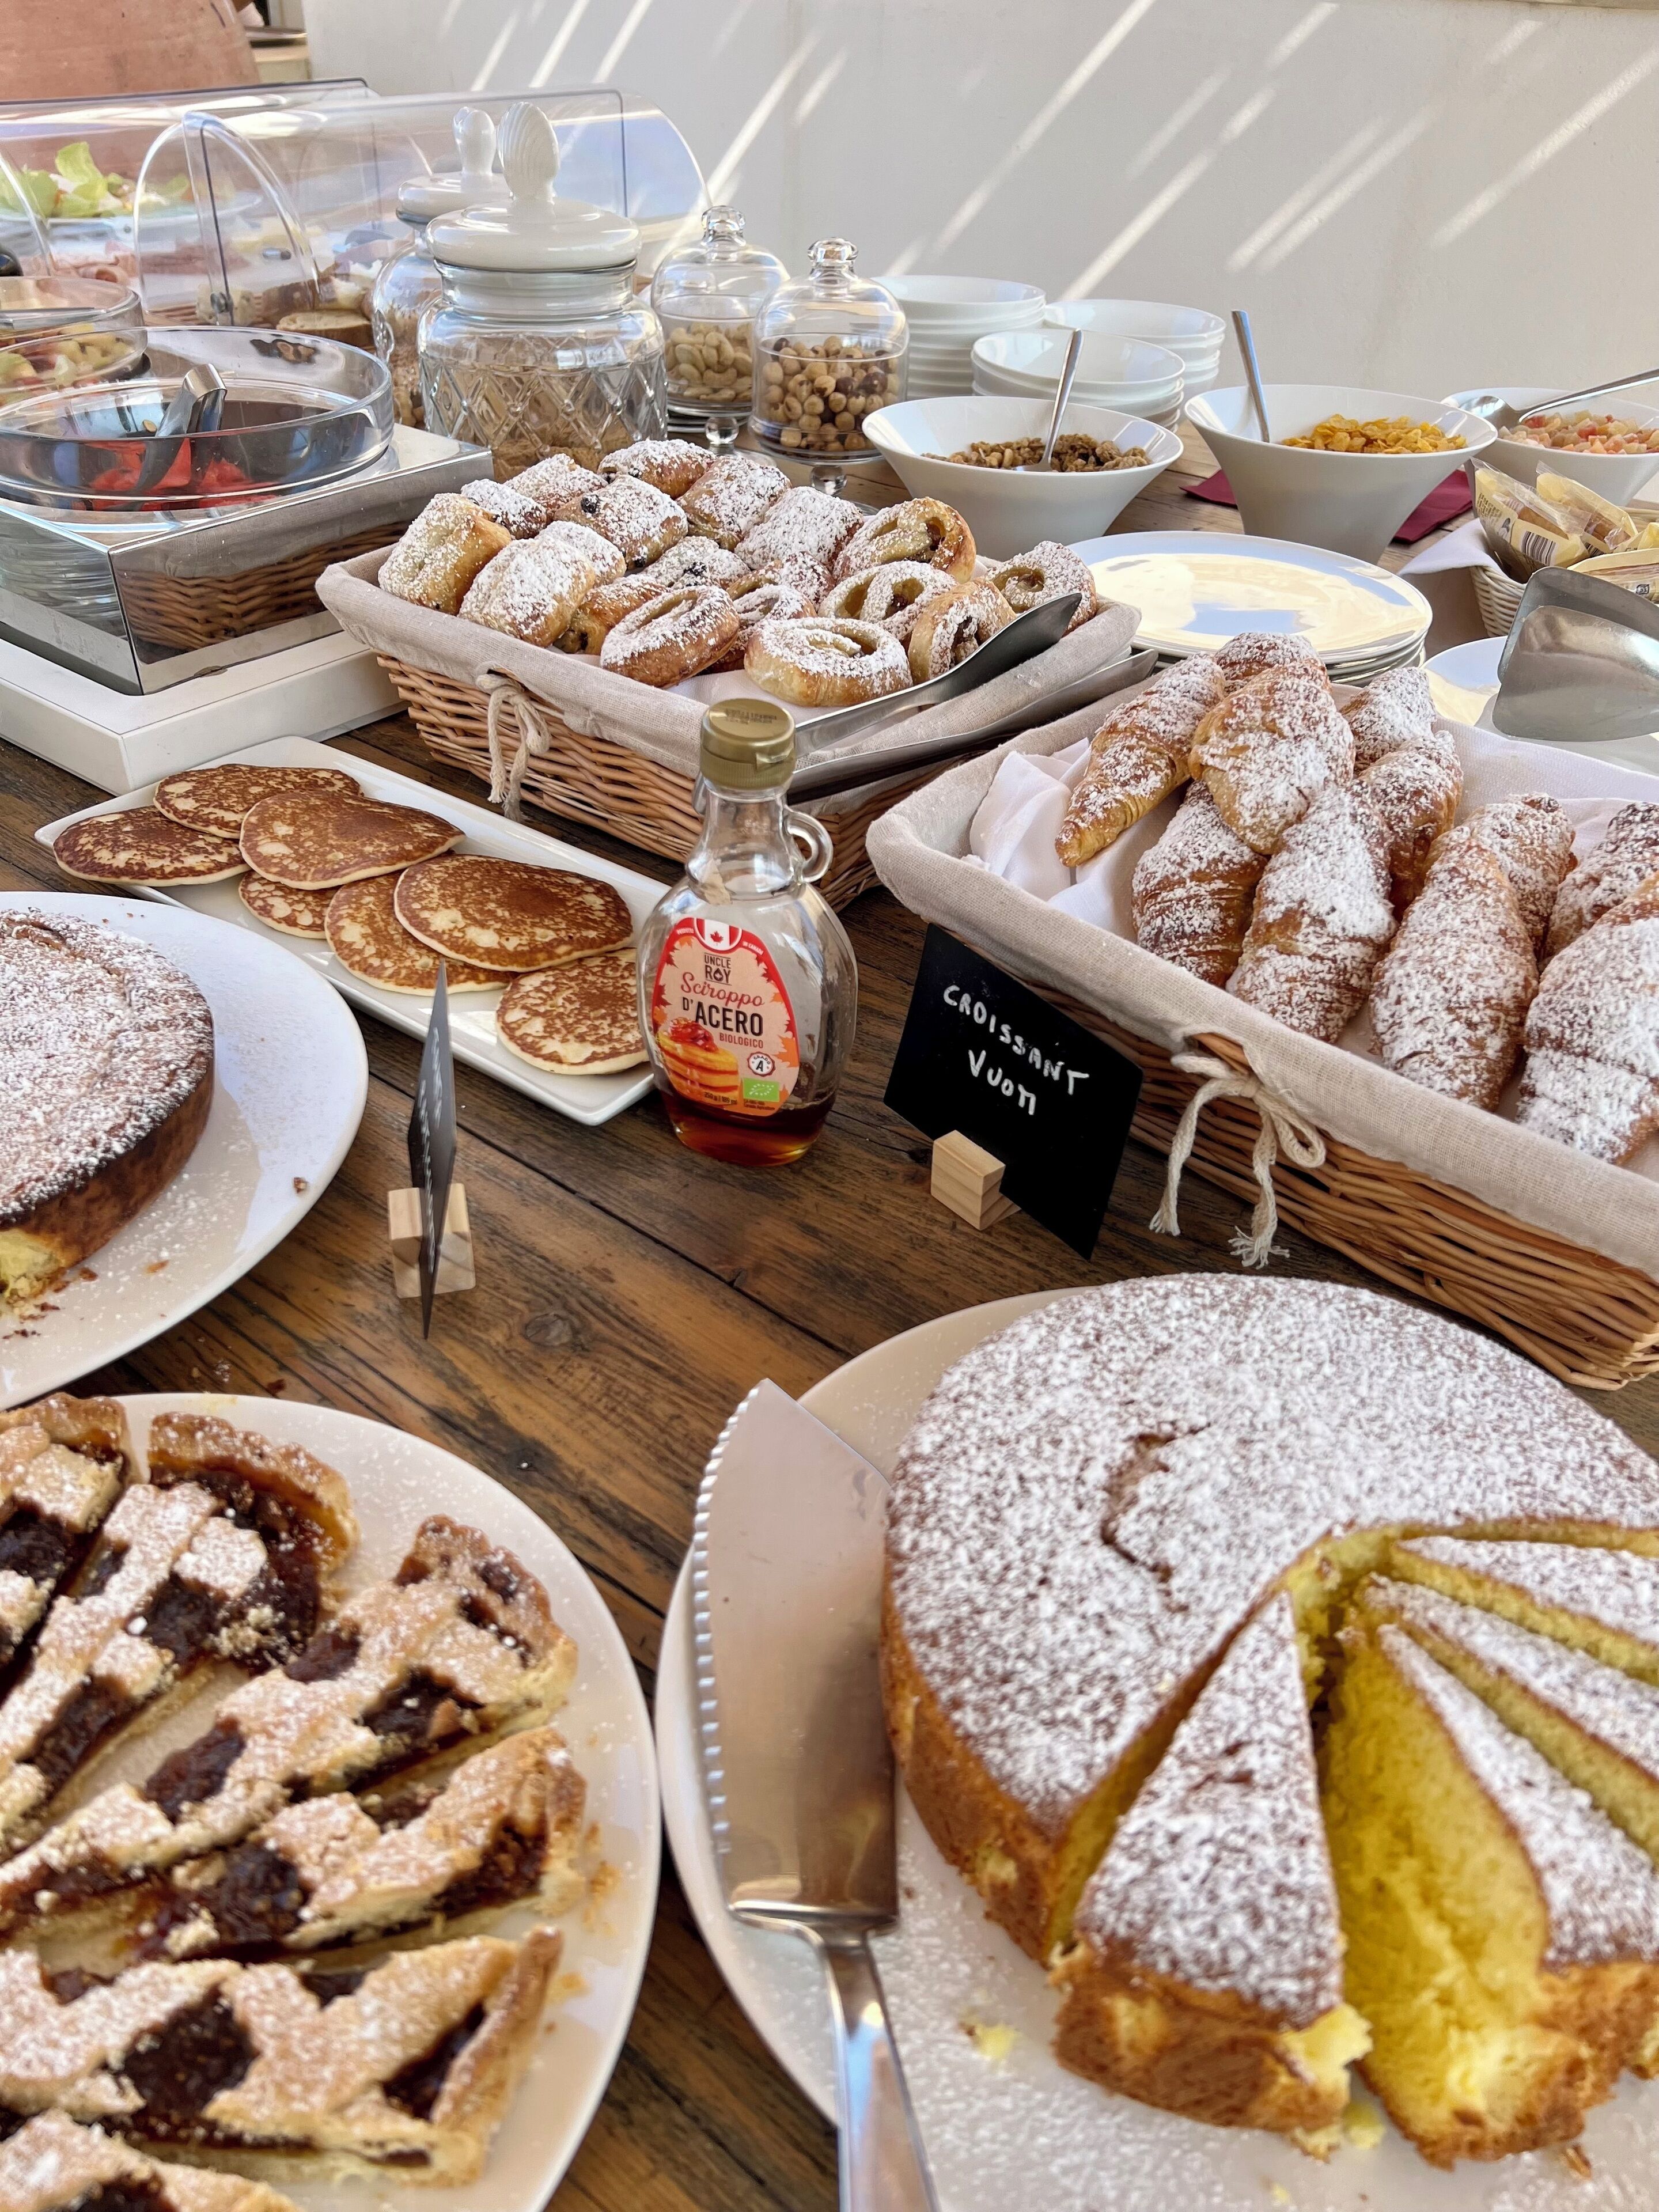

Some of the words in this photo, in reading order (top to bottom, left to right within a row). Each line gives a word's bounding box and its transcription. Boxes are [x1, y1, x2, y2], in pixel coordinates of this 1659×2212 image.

[704, 955, 732, 969] UNCLE
[704, 965, 732, 984] ROY
[681, 972, 765, 1009] Sciroppo
[719, 1032, 764, 1049] BIOLOGICO
[943, 984, 1090, 1095] CROISSANT
[753, 1055, 771, 1065] GRADO
[756, 1059, 764, 1072] A
